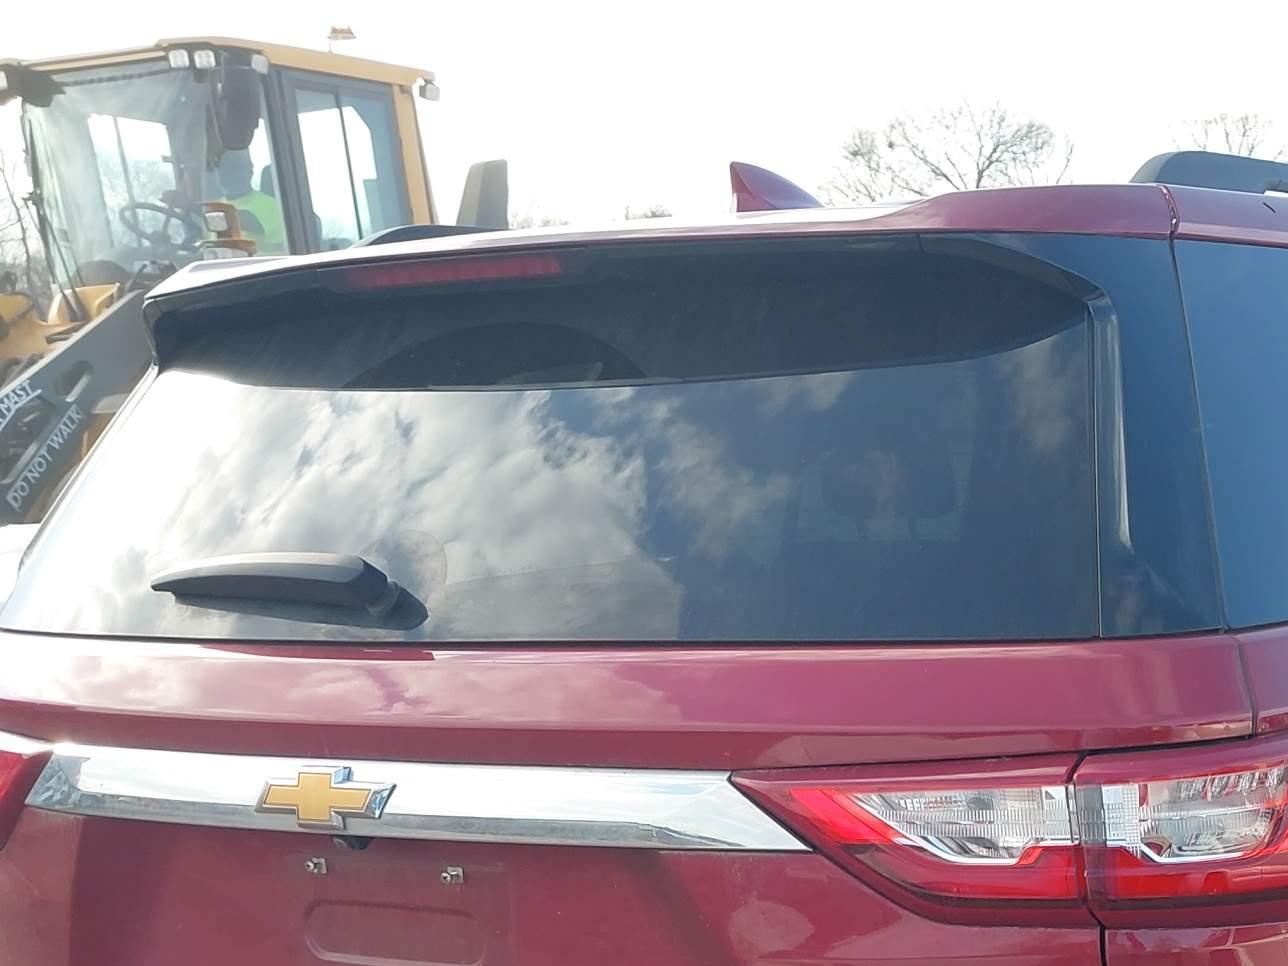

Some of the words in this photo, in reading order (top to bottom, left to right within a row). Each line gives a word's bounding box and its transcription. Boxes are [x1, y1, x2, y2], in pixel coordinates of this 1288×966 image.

[6, 480, 31, 512] DO
[23, 447, 52, 485] NOT
[48, 404, 83, 450] WALK
